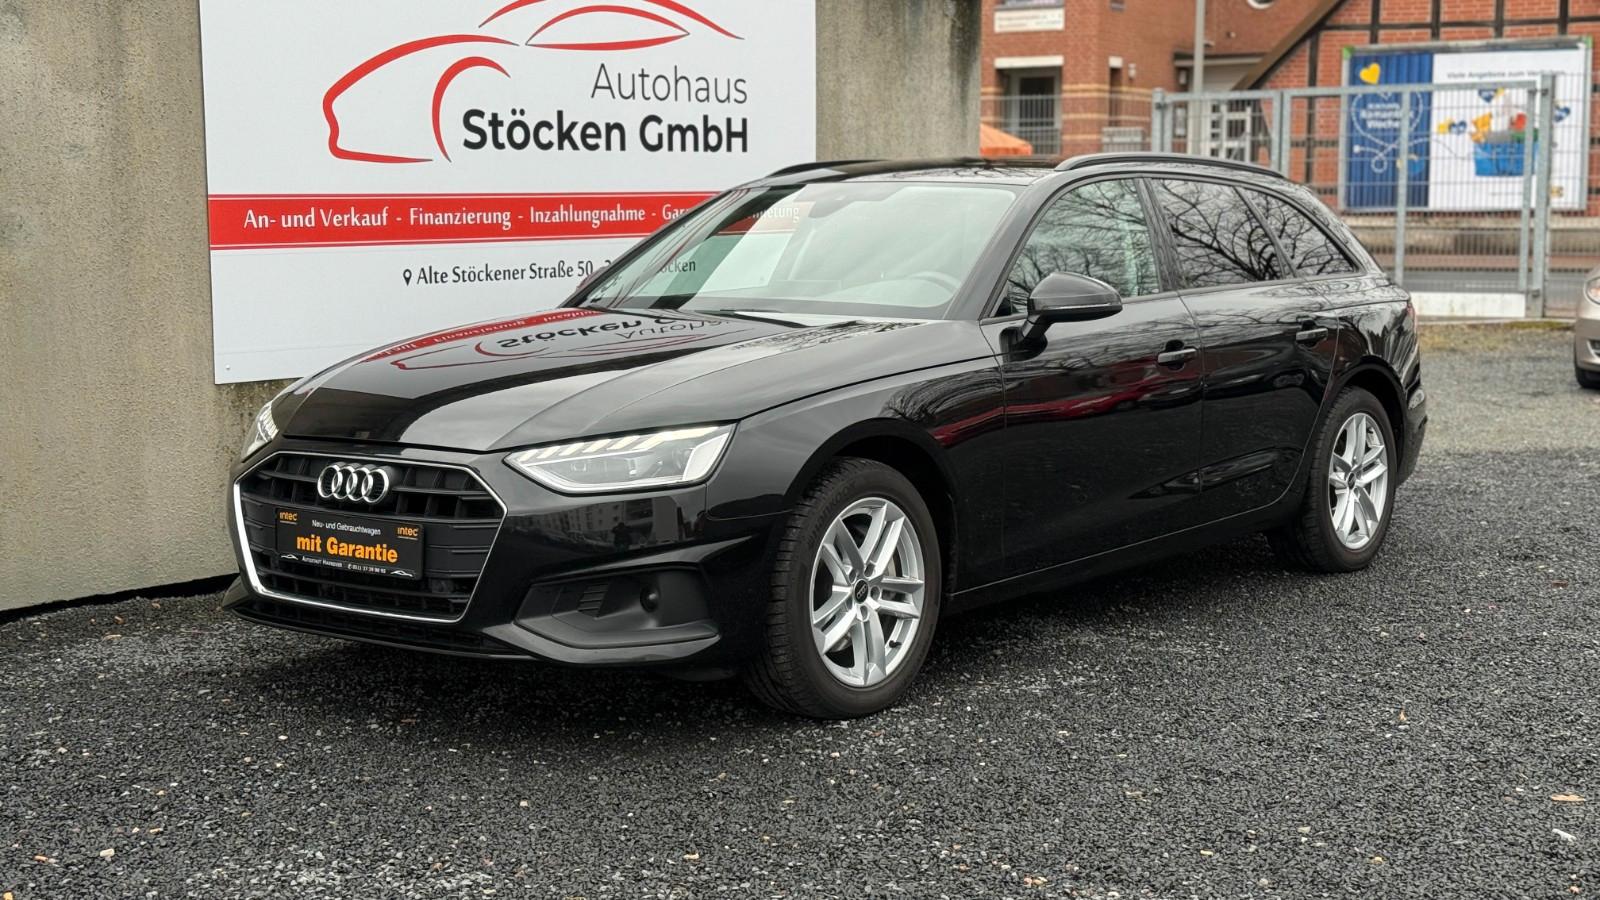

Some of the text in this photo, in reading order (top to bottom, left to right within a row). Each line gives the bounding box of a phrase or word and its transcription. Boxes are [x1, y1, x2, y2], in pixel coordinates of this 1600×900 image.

[591, 63, 748, 104] Autohaus
[462, 108, 748, 152] Stöcken GmbH
[243, 209, 276, 229] An-
[281, 207, 316, 228] und
[319, 206, 389, 227] Verkauf
[410, 207, 512, 230] Finanzierung
[530, 204, 646, 228] Inzahlungnahme
[417, 265, 449, 285] Alte
[452, 261, 526, 283] Stöckener
[529, 259, 574, 279] Straße
[577, 260, 594, 277] 50
[312, 519, 382, 537] Neu- und Gebrauchtwagen
[296, 534, 399, 563] mit Garantie
